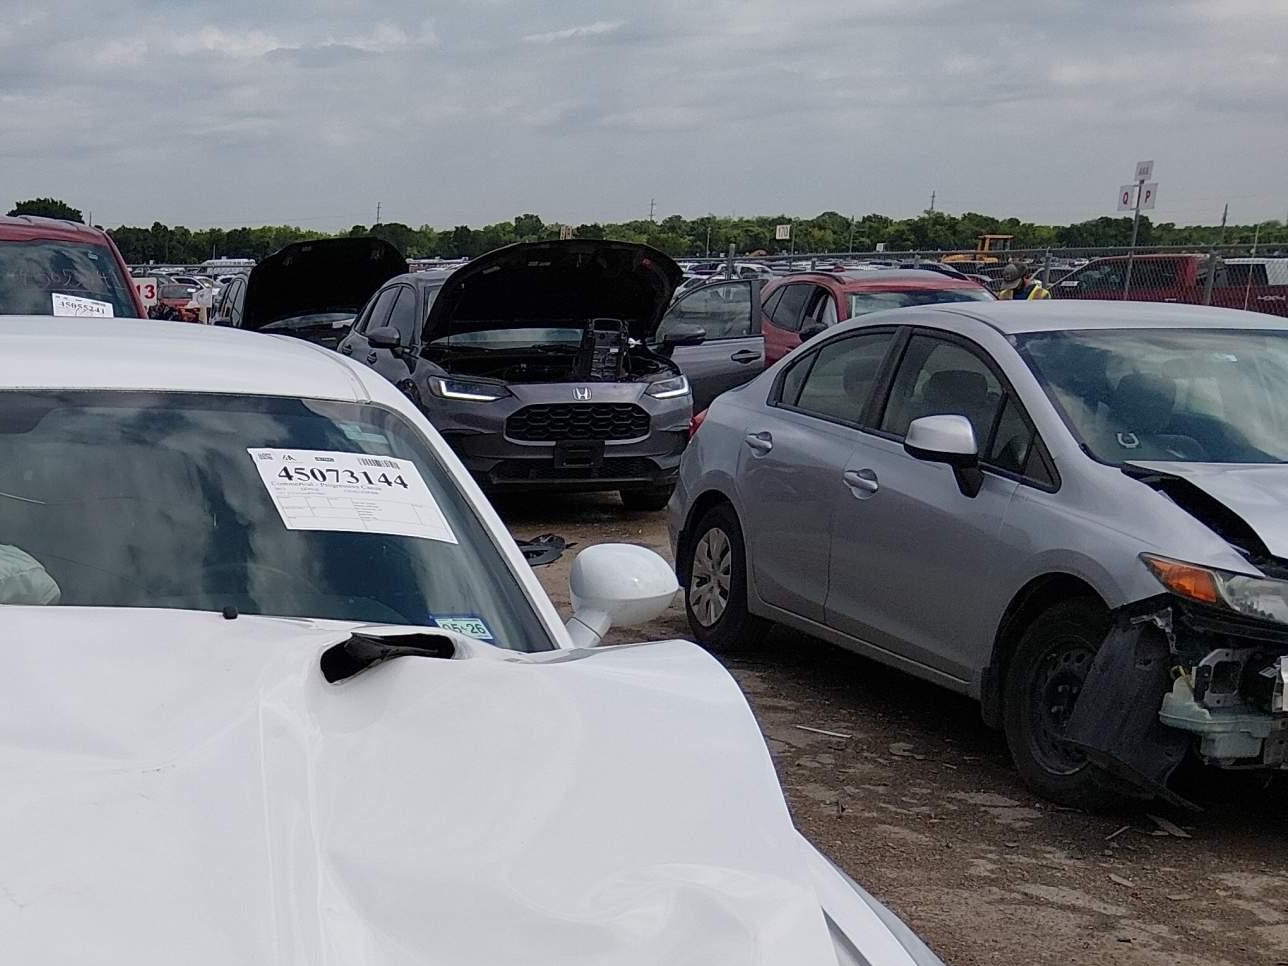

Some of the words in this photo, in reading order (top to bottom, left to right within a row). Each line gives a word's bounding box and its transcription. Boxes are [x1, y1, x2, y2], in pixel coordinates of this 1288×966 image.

[1145, 190, 1151, 203] P
[136, 284, 156, 299] 13
[278, 465, 409, 489] 45073144
